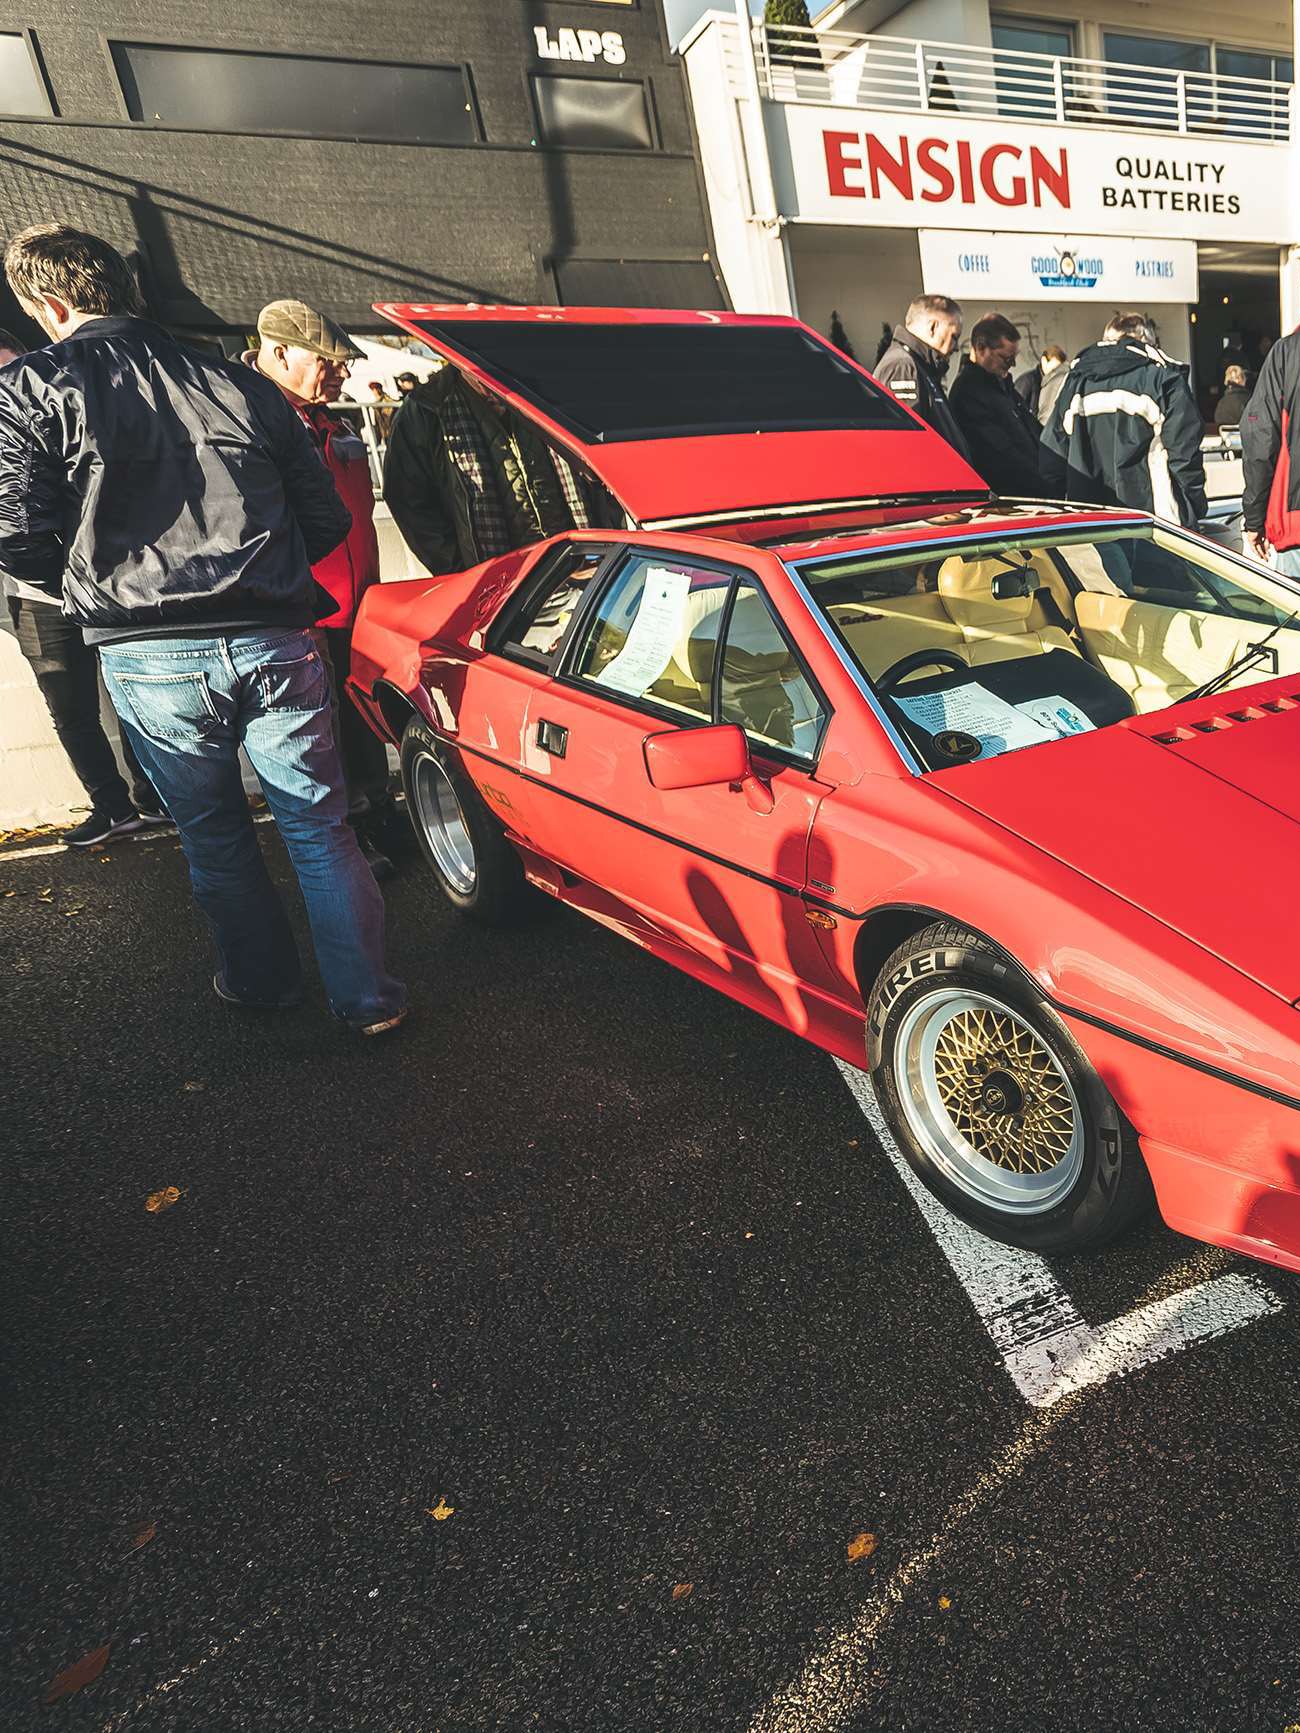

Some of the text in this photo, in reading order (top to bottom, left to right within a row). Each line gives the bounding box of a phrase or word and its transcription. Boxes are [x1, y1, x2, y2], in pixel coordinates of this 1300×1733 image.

[532, 25, 627, 65] LAPS
[822, 129, 1071, 210] ENSIGN
[1115, 157, 1226, 184] QUALITY
[1102, 187, 1242, 215] BATTERIES
[958, 254, 990, 273] COFFEE
[1135, 260, 1175, 278] PASTRIES
